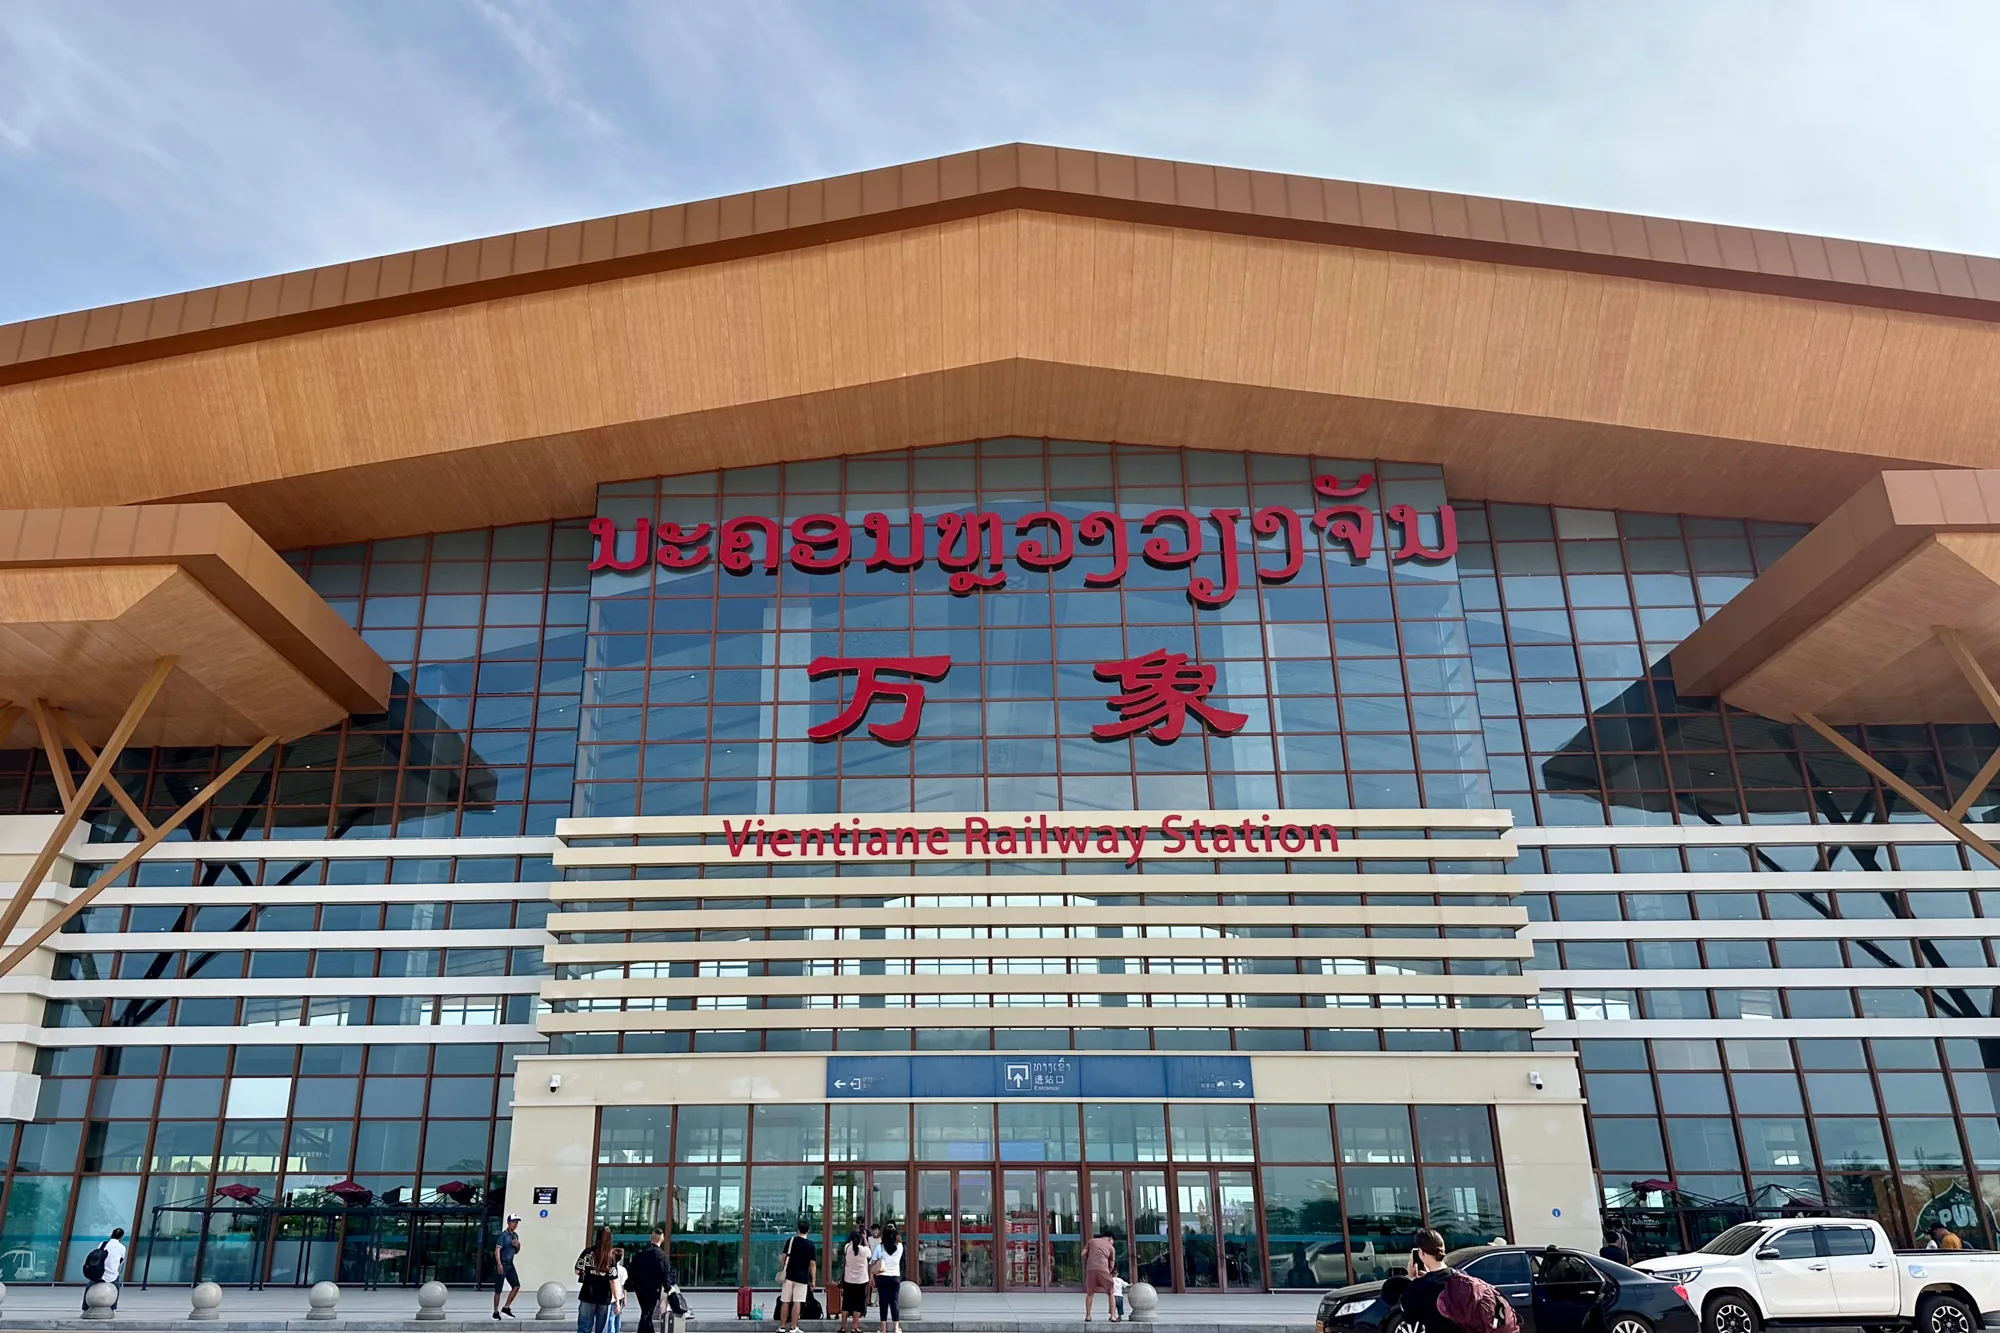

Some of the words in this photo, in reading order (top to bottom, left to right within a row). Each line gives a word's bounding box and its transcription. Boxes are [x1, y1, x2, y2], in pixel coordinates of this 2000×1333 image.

[723, 818, 950, 858] Vientiane
[965, 813, 1148, 866] Railway
[1162, 814, 1339, 854] Station
[1034, 1074, 1064, 1085] 进站口
[1631, 1218, 1660, 1226] Amazon
